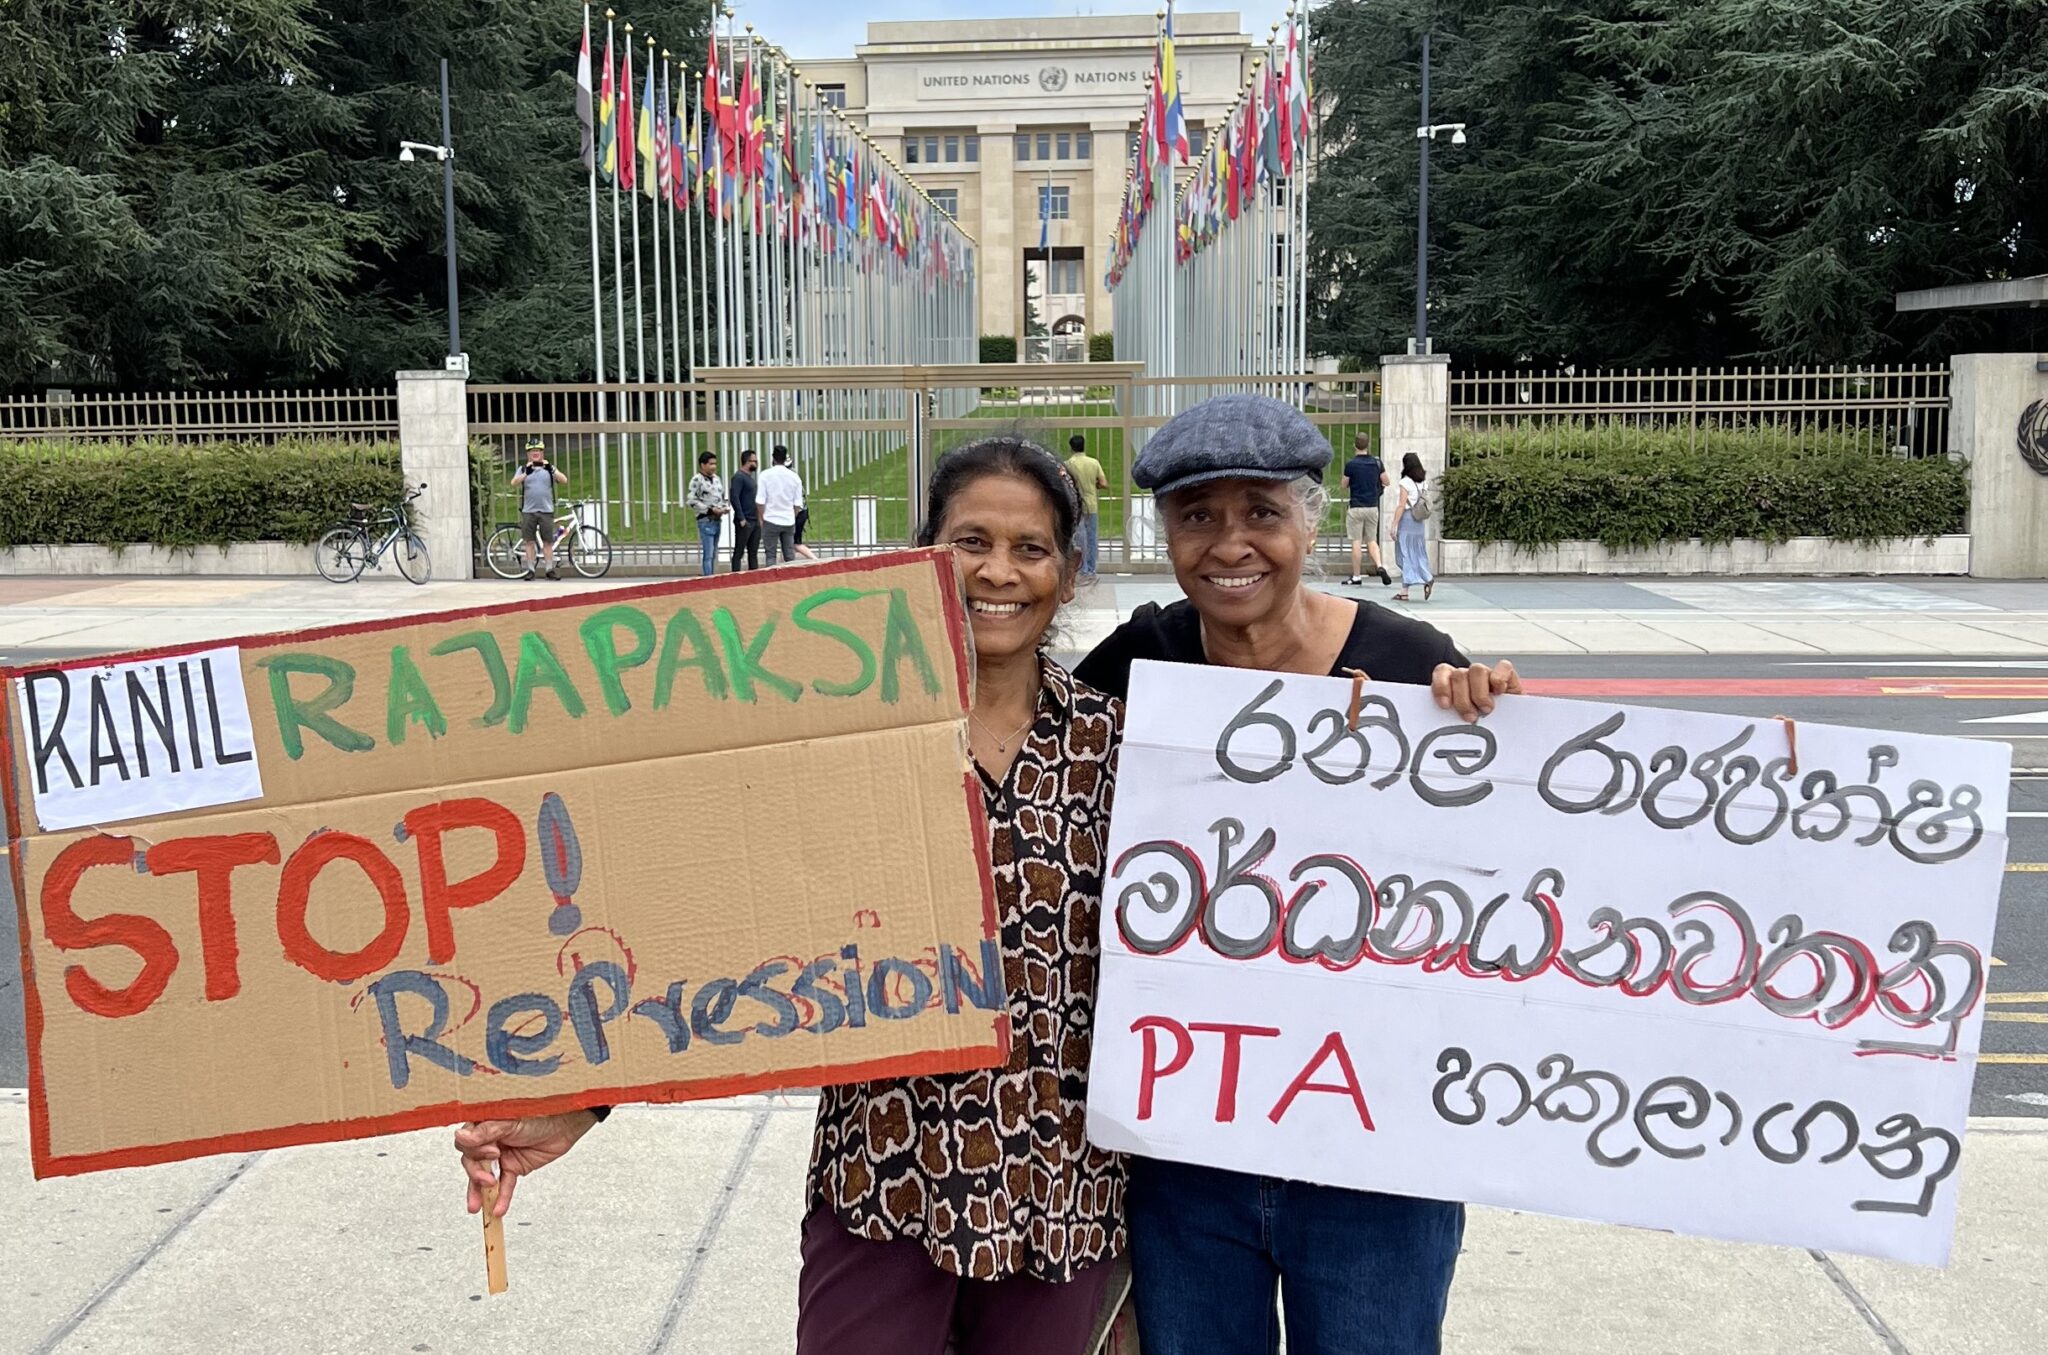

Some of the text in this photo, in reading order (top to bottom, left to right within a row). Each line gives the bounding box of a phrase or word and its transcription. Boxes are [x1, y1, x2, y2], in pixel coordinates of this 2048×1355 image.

[923, 76, 968, 87] UNITED
[972, 74, 1031, 86] NATIONS
[1074, 71, 1137, 83] NATIONS
[24, 587, 943, 794] RANIL RAJAPAKSA
[40, 791, 583, 1018] STOP!
[1130, 1014, 1376, 1132] PTA
